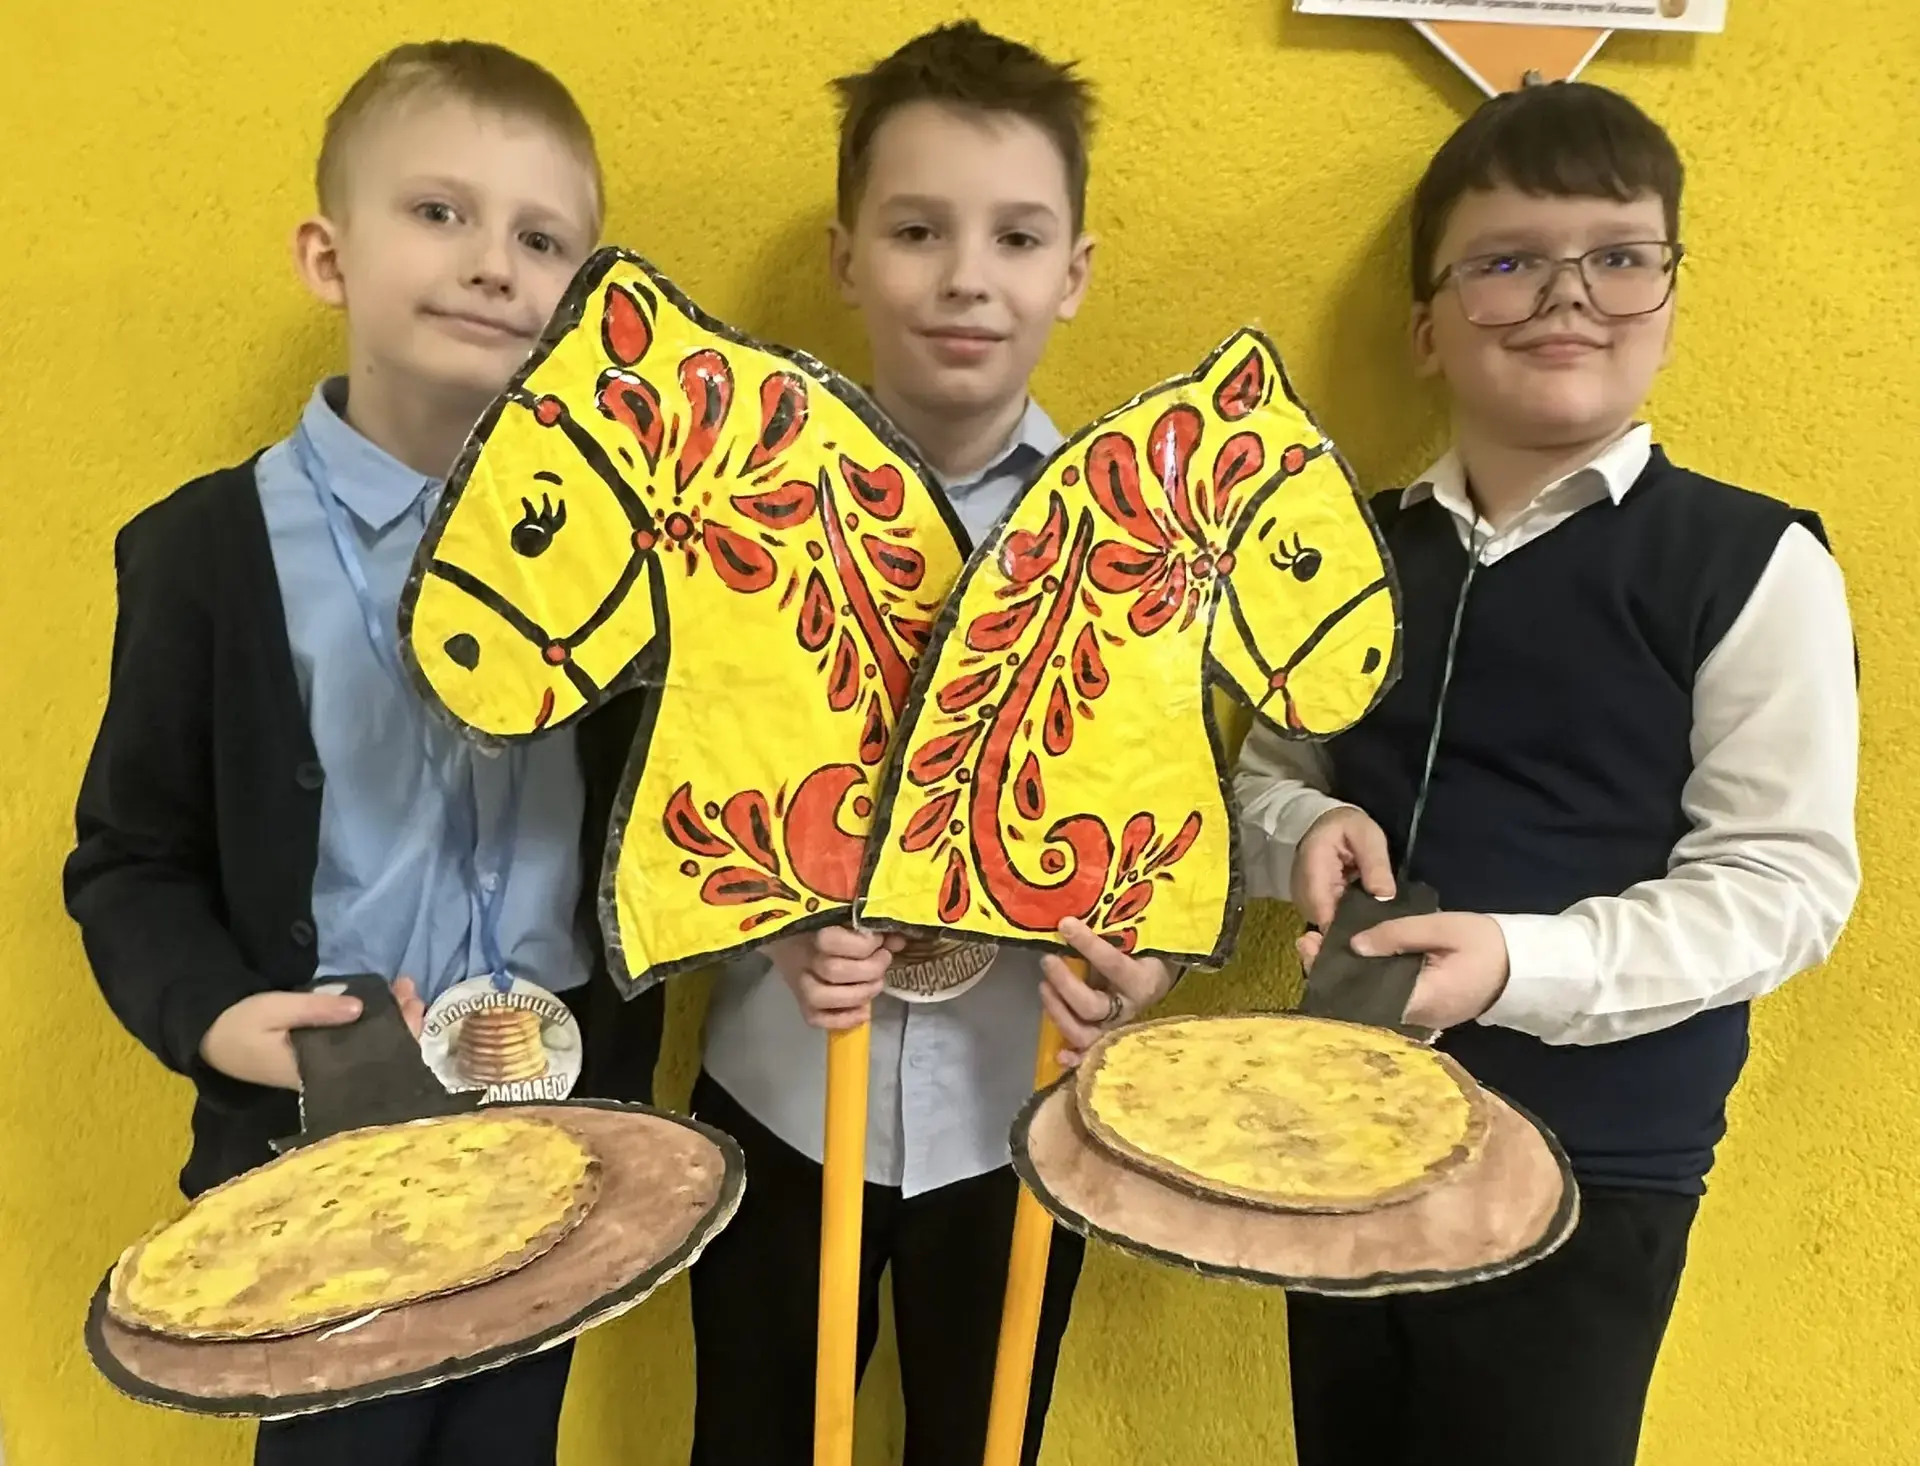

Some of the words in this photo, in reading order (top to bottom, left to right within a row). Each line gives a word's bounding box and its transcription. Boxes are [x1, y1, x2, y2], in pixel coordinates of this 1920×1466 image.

[424, 1022, 441, 1036] С
[438, 992, 571, 1026] МАСЛЕНИЦЕЙ
[449, 1073, 568, 1103] РАВЛЯЕМ
